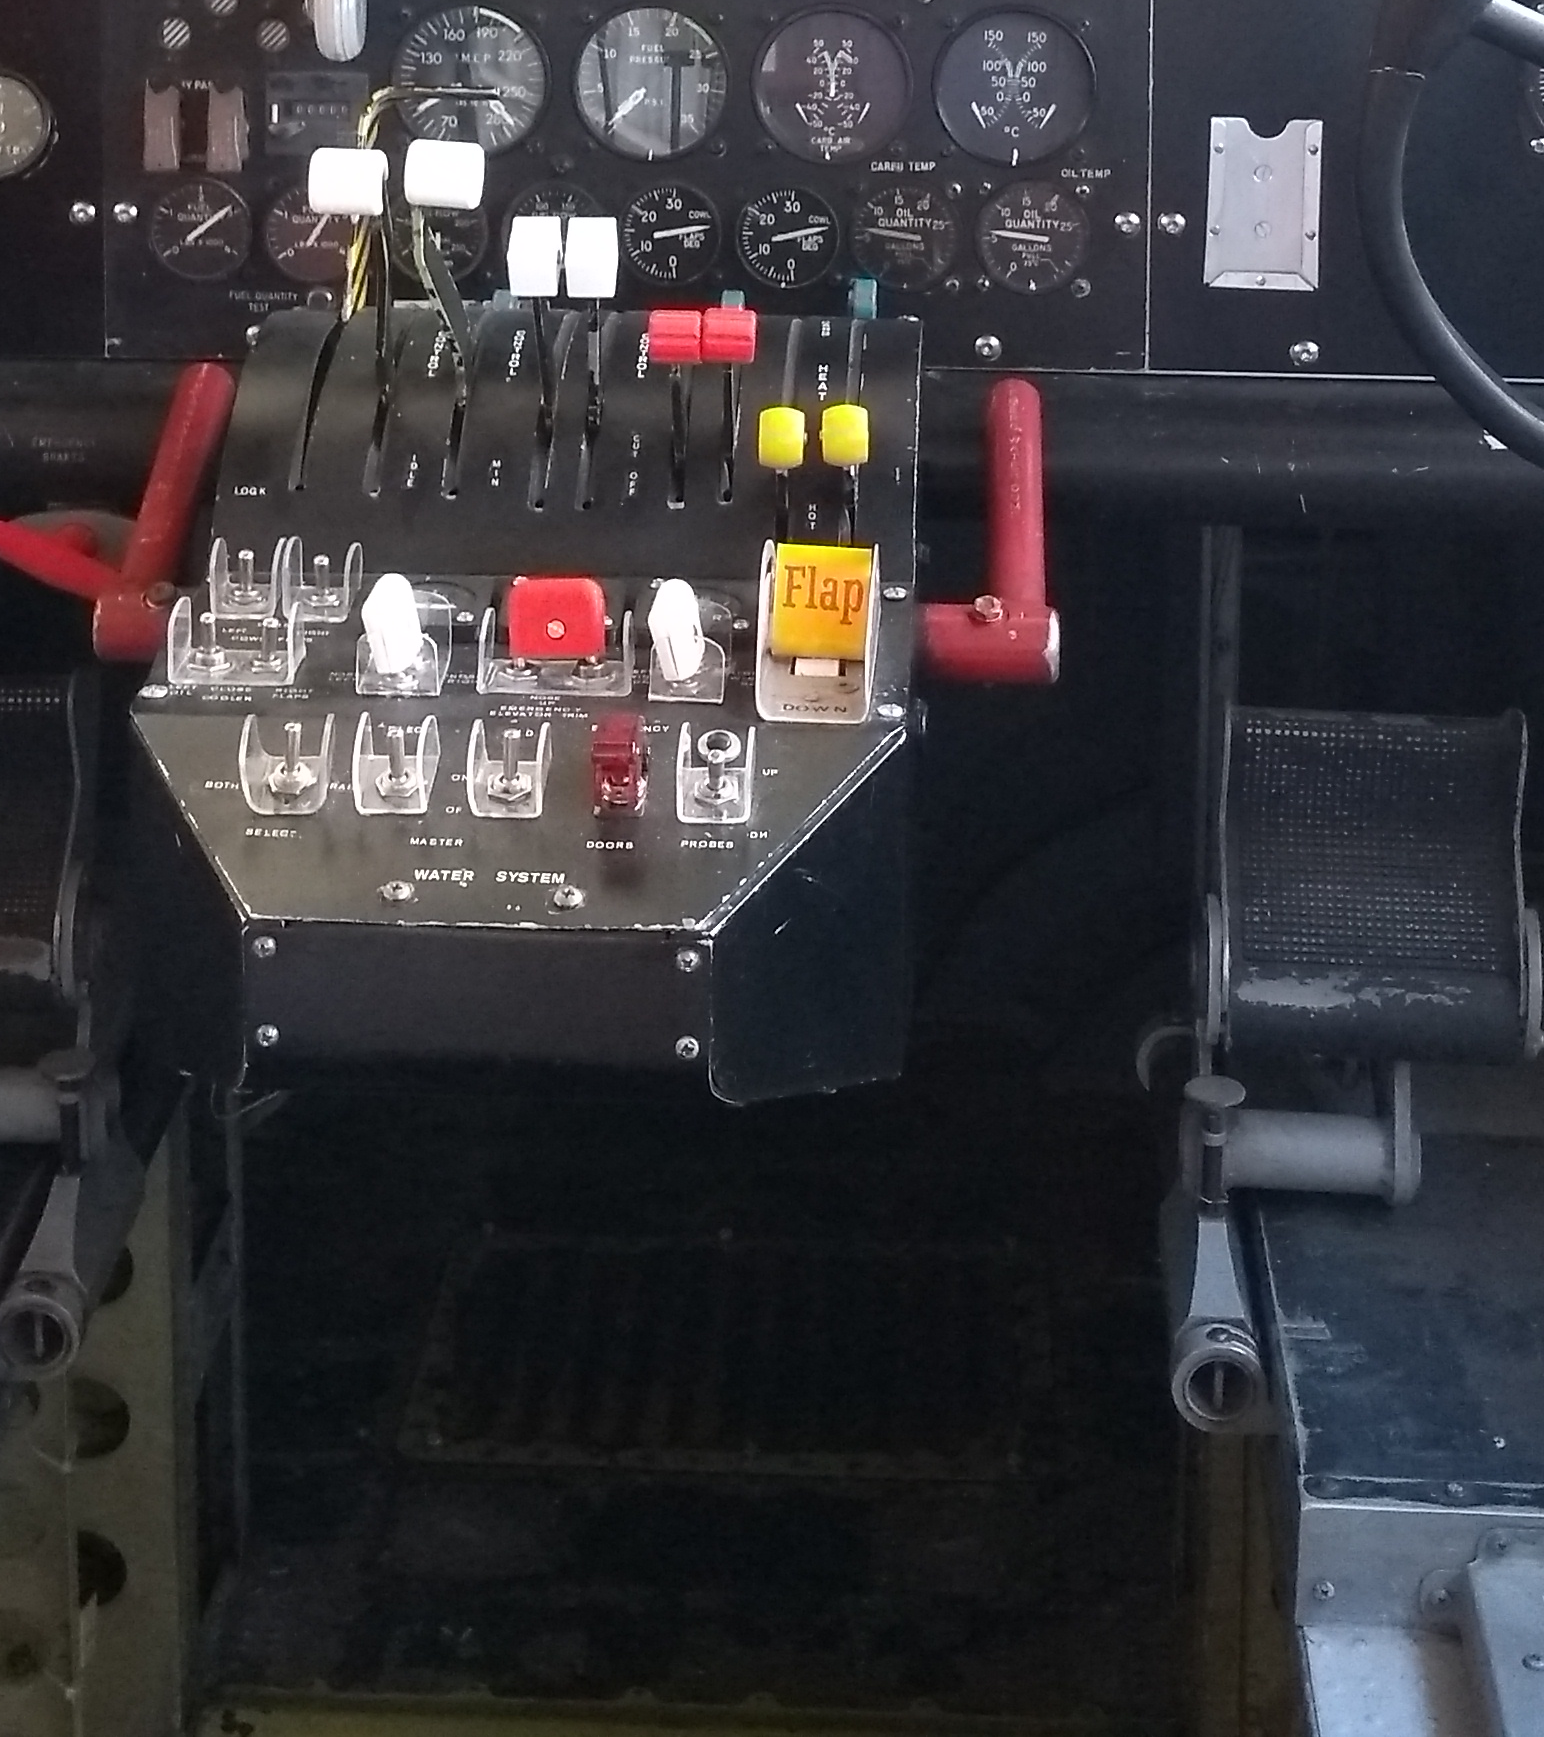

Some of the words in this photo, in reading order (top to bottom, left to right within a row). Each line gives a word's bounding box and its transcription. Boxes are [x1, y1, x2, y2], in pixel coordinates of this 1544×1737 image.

[443, 28, 465, 41] 160
[665, 27, 679, 37] 20
[984, 30, 1003, 42] 150
[1027, 31, 1047, 43] 150
[420, 52, 442, 64] 130
[604, 49, 616, 59] 10
[983, 60, 1001, 71] 100
[1027, 61, 1047, 73] 100
[991, 77, 1006, 87] 50
[1021, 77, 1036, 88] 50
[503, 86, 526, 97] 250
[441, 115, 458, 127] 70
[908, 162, 936, 171] TEMP
[1061, 169, 1078, 178] OIL
[1082, 169, 1112, 178] TEMP
[665, 198, 683, 210] 30
[784, 201, 801, 212] 30
[641, 210, 657, 222] 20
[688, 210, 711, 219] COWL
[896, 208, 913, 217] OIL
[1023, 209, 1041, 219] OIL
[759, 213, 775, 225] 20
[808, 215, 831, 224] COWL
[878, 217, 931, 228] QUANTITY
[1005, 219, 1059, 229] QUANTITY
[640, 240, 652, 251] 10
[684, 239, 701, 248] DEG
[759, 243, 771, 255] 10
[1012, 244, 1052, 252] GALLONS
[229, 291, 252, 300] FUEL
[255, 292, 299, 301] QUANTITY
[248, 301, 270, 311] TEST
[817, 364, 830, 401] HEAT
[406, 454, 419, 487] IDLE
[490, 459, 502, 486] MIN
[628, 471, 638, 496] OFF
[807, 504, 818, 529] HOT
[782, 564, 865, 626] Flap
[782, 704, 847, 713] DOWN
[762, 768, 778, 776] UP
[204, 781, 239, 790] BOTH
[410, 836, 464, 847] MASTER
[586, 840, 634, 850] DOORS
[680, 839, 734, 850] PROBES
[414, 868, 475, 882] WATER
[496, 871, 566, 885] SYSTEM
